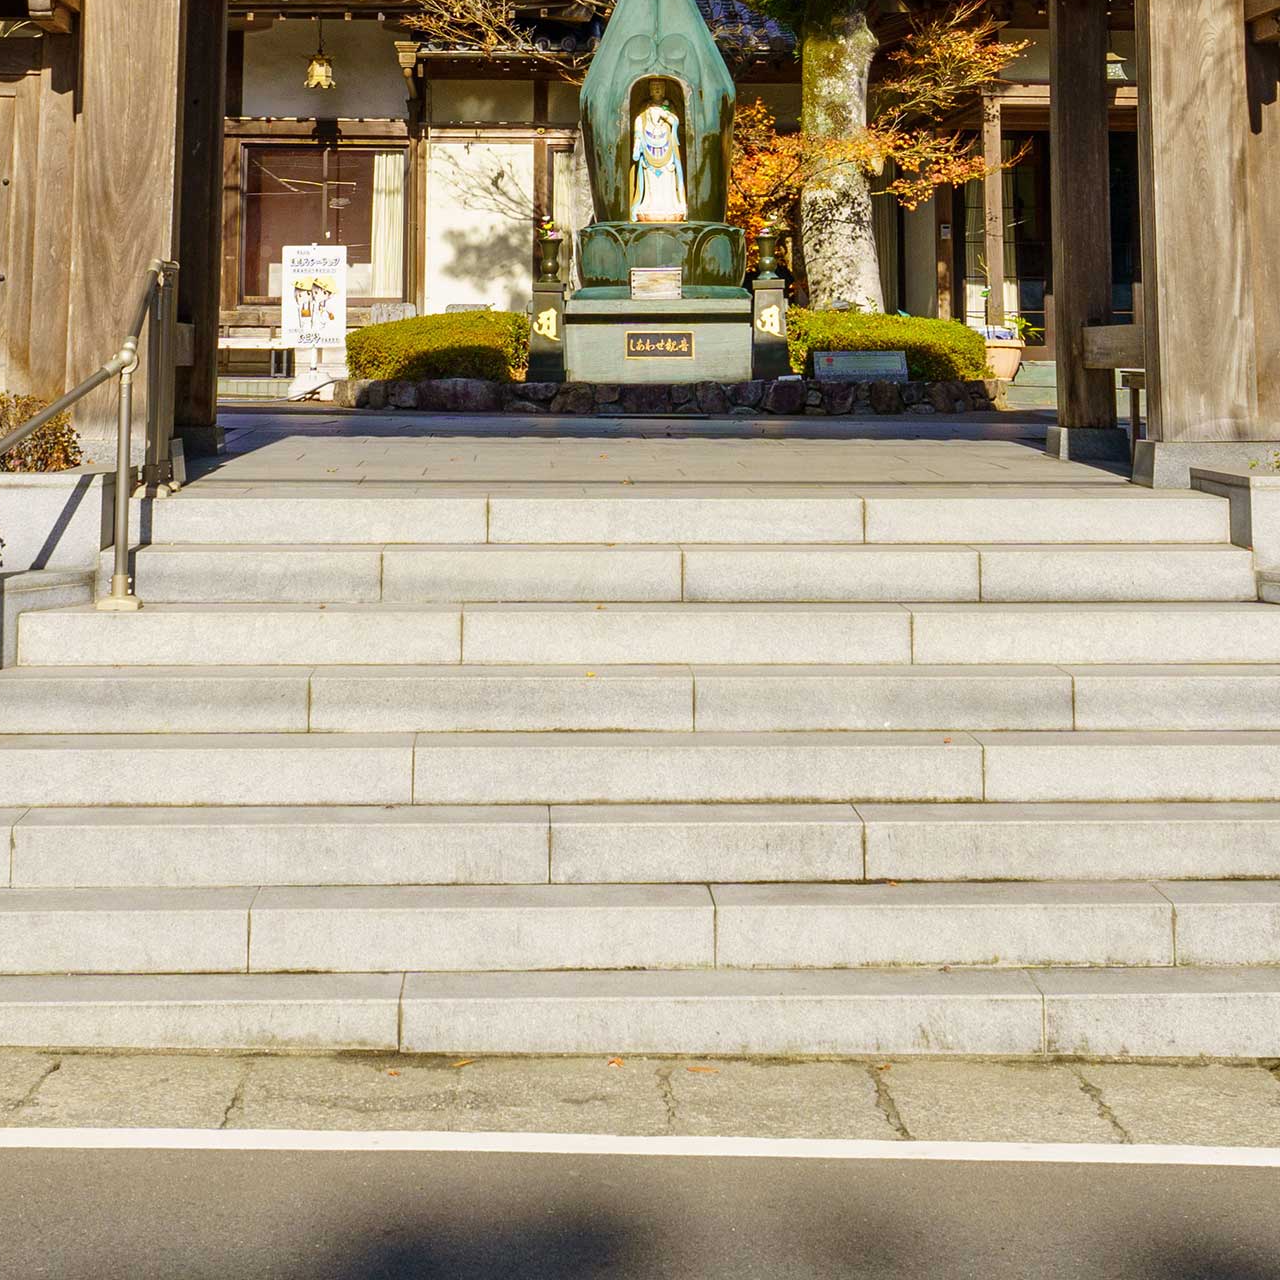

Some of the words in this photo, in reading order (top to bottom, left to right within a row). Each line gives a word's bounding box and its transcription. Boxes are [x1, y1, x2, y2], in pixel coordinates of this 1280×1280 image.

[629, 336, 690, 352] しあわせ観音
